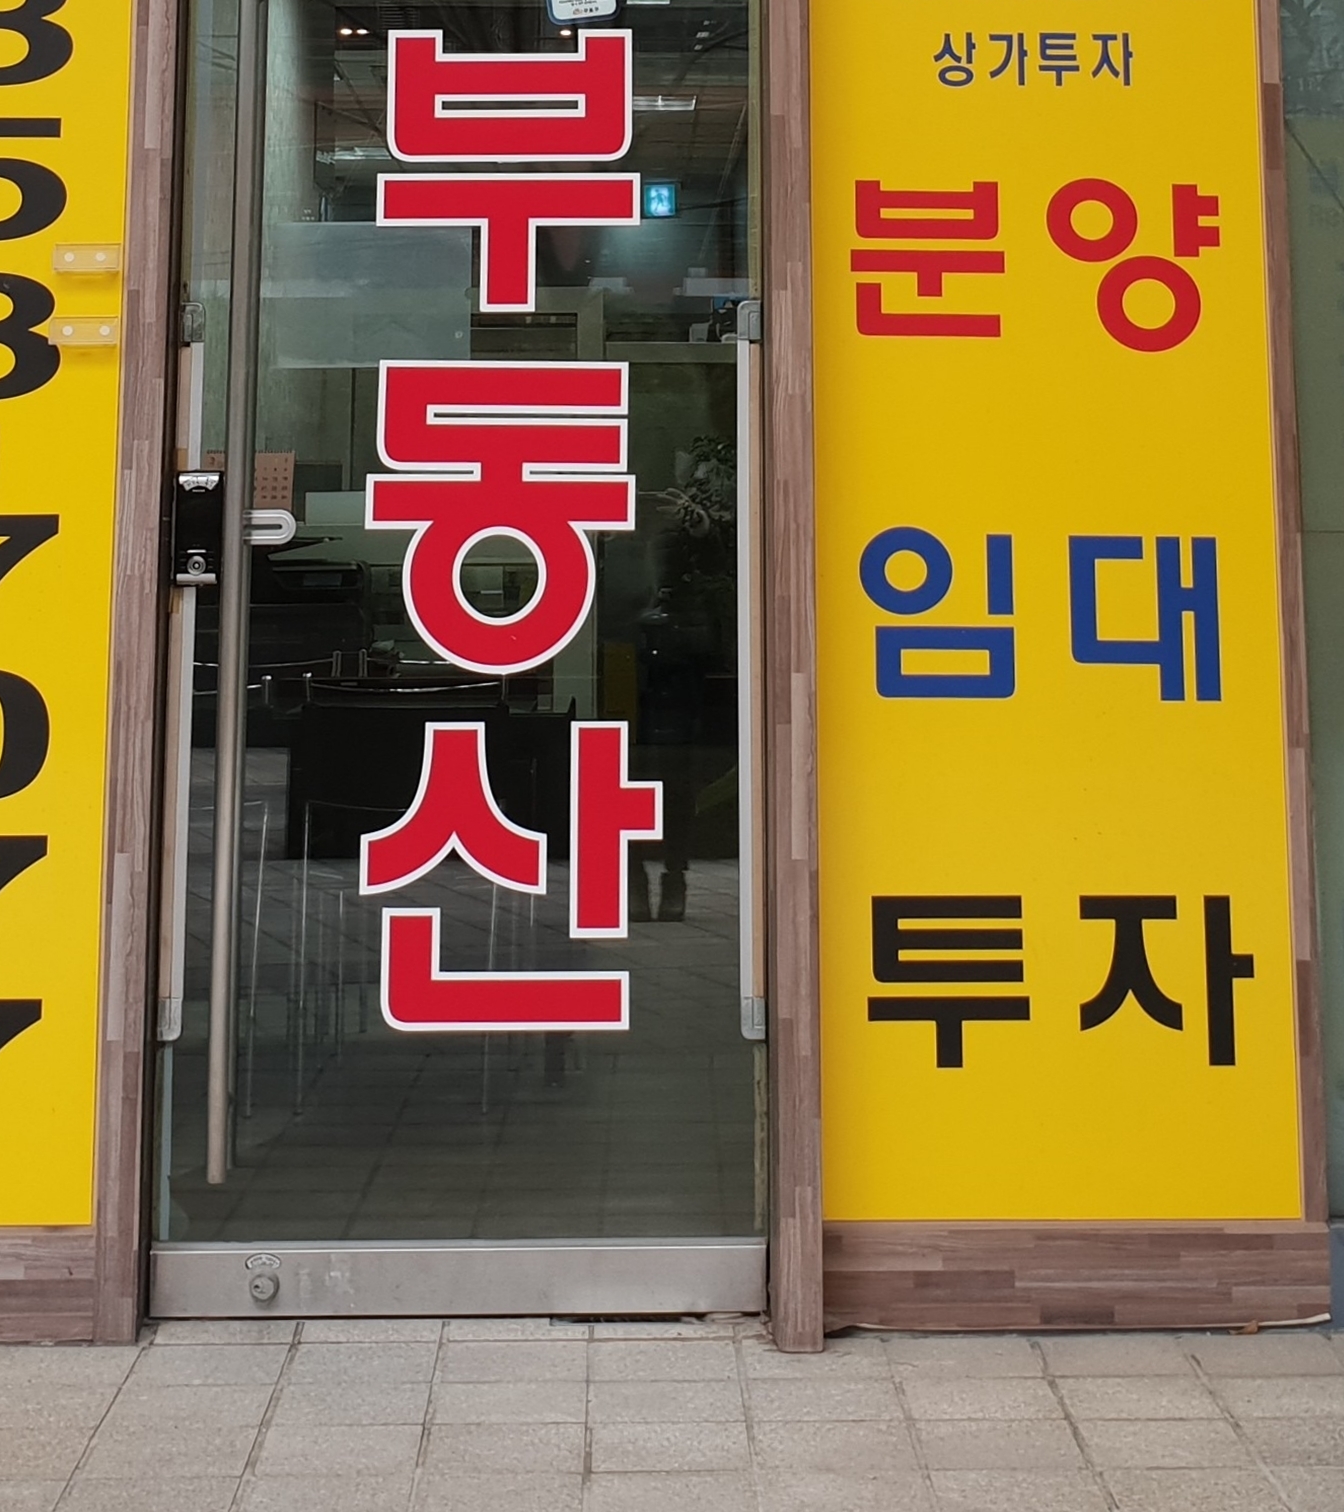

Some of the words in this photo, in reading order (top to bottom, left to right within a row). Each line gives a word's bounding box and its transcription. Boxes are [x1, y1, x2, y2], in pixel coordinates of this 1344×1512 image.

[932, 31, 1134, 87] 상가투자
[850, 177, 1221, 353] 분양
[359, 28, 664, 1033] 부동산
[859, 525, 1222, 702] 임대
[867, 894, 1255, 1069] 투자
